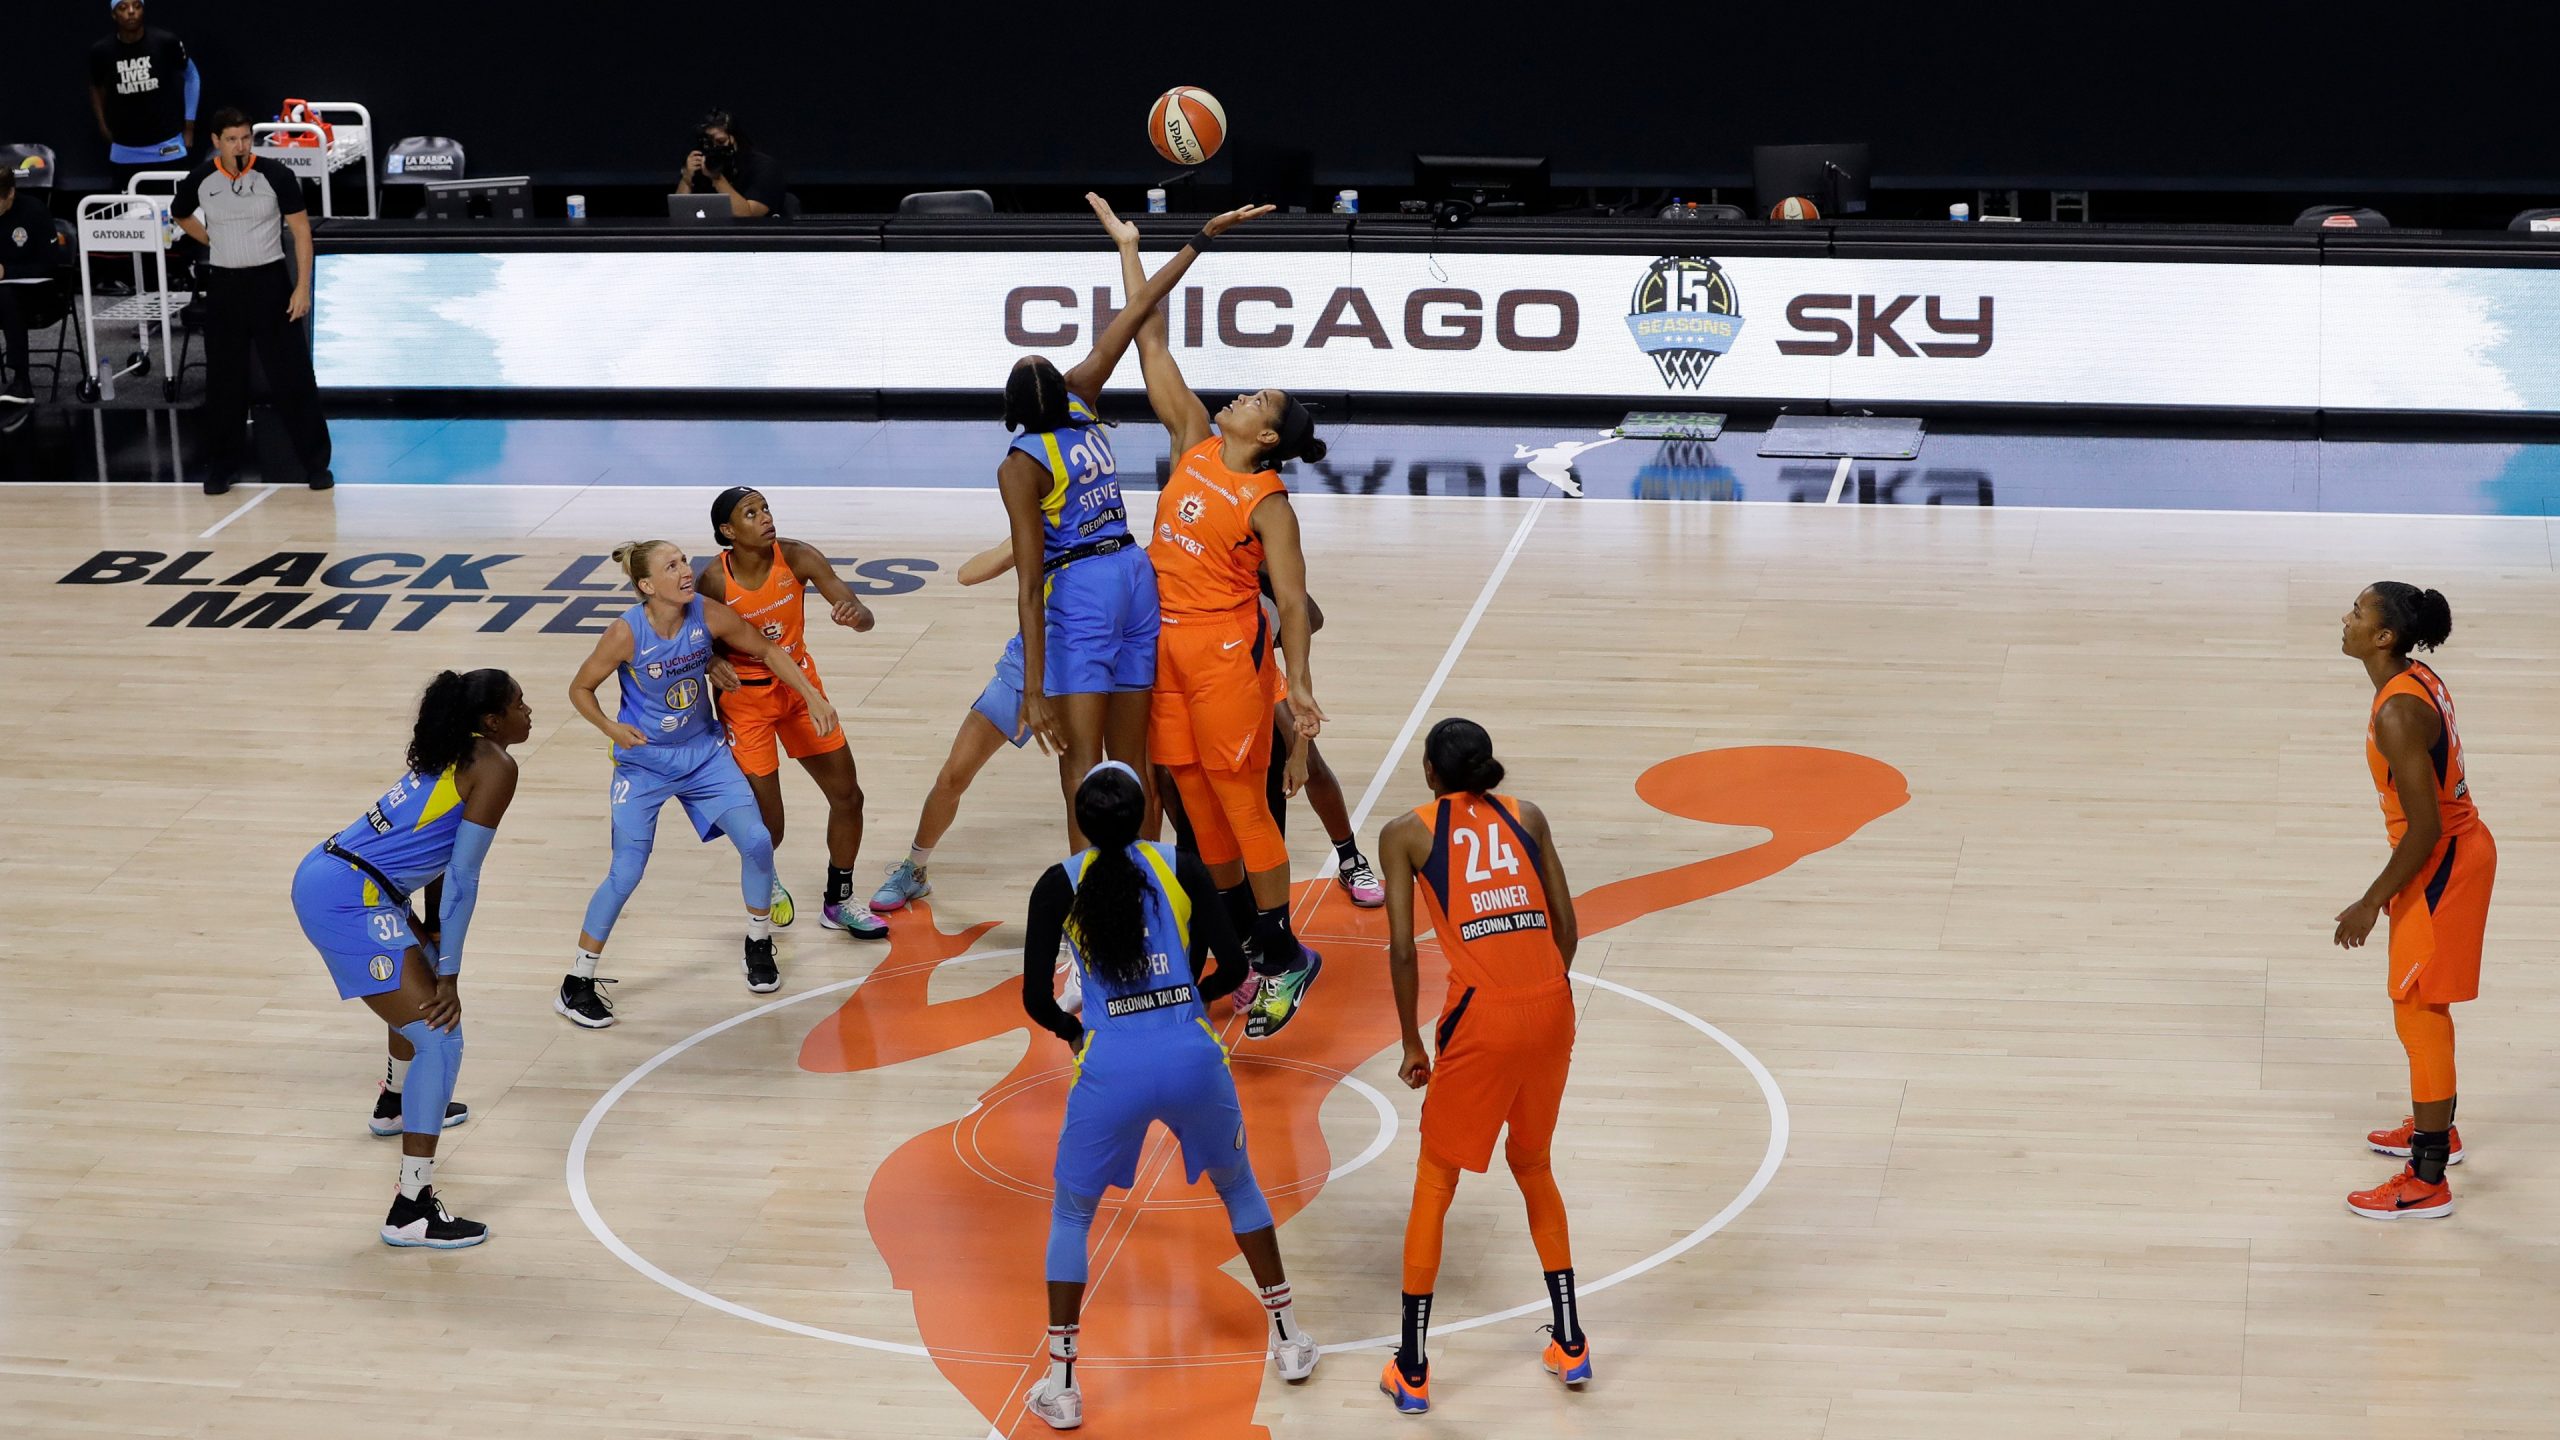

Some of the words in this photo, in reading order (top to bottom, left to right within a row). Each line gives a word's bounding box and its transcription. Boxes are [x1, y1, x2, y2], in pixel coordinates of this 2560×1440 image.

[116, 56, 152, 73] BLACK
[121, 68, 150, 83] LIVES
[116, 78, 159, 94] MATTER
[405, 155, 418, 165] LA
[419, 155, 454, 165] RABIDA
[92, 230, 146, 240] GATORADE
[1662, 269, 1709, 312] 15
[1003, 285, 1580, 352] CHICAGO
[1637, 318, 1732, 337] SEASONS
[1775, 293, 1994, 358] SKY
[1069, 428, 1115, 485] 30
[1079, 481, 1119, 512] STEVE
[1183, 501, 1199, 517] C
[1079, 509, 1114, 538] BREONNA
[1174, 533, 1206, 557] AT&T
[55, 550, 527, 590] BLACK
[146, 591, 643, 635] MATTE
[664, 648, 708, 669] UChicago
[1453, 823, 1520, 884] 24
[1470, 885, 1530, 914] BONNER
[373, 913, 404, 941] 32
[1461, 916, 1513, 940] BREONNA
[1512, 912, 1547, 930] TAYLOR
[1107, 994, 1155, 1016] BREONNA
[1155, 986, 1192, 1006] TAYLOR
